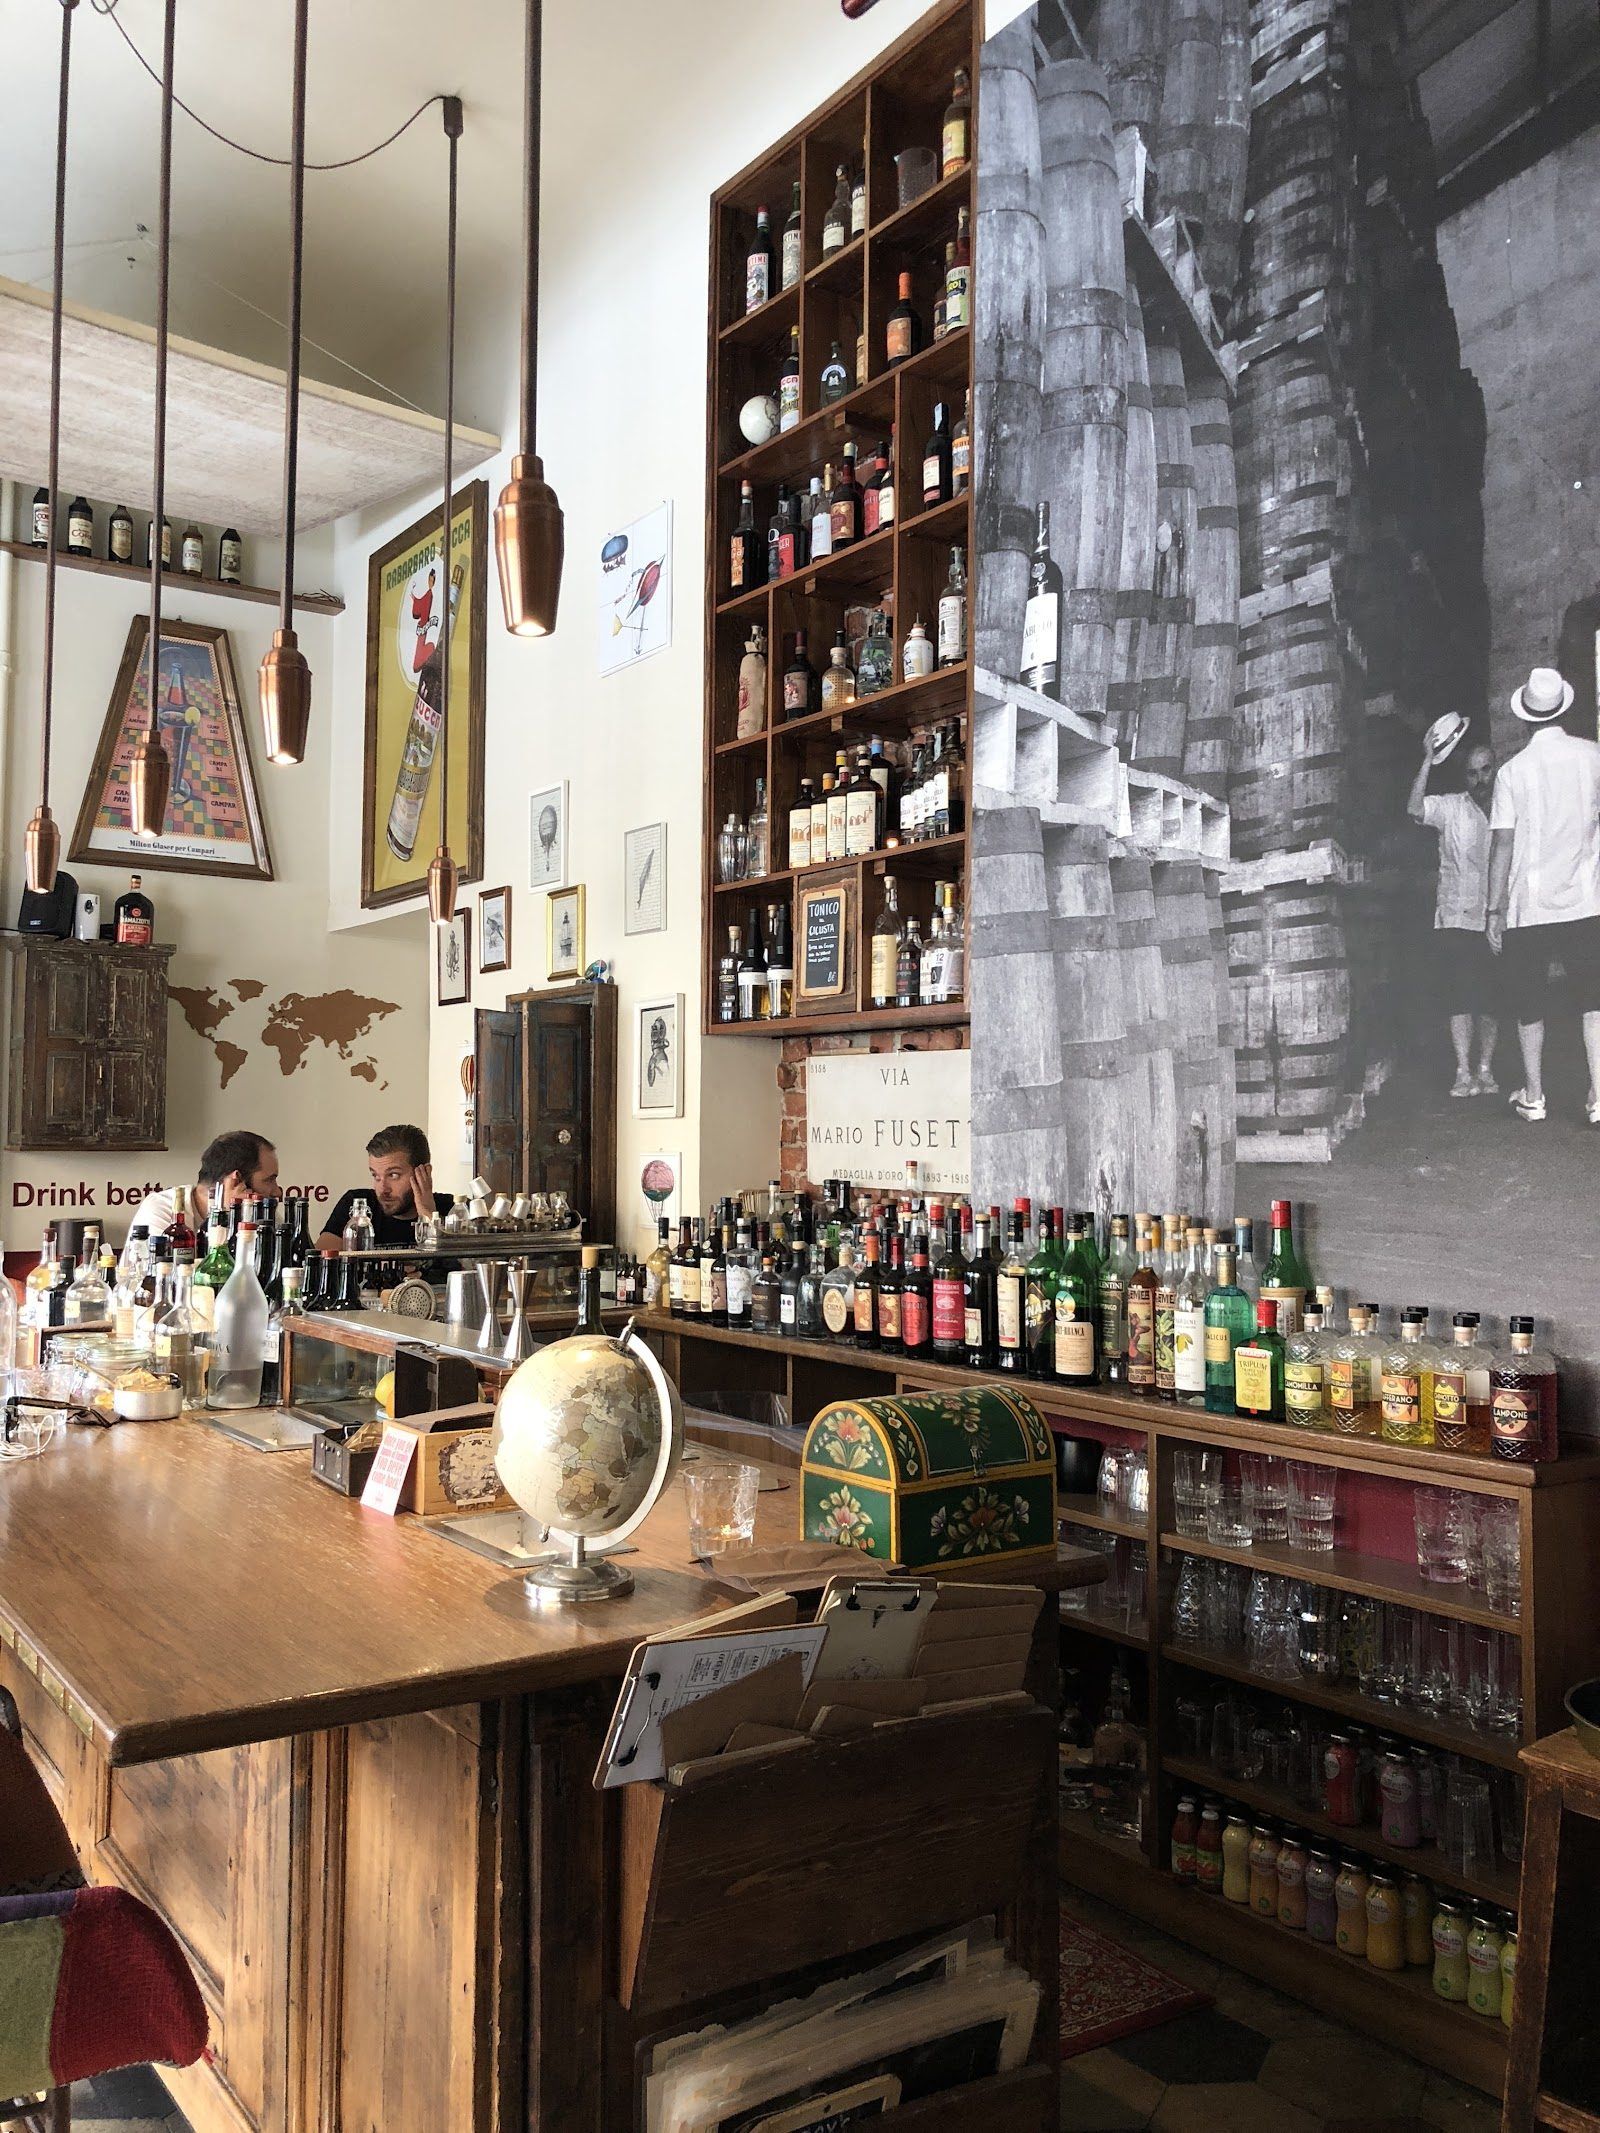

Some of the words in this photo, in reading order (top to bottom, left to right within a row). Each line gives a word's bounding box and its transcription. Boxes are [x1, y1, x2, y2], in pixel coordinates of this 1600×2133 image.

[386, 542, 436, 592] RABARBARO
[440, 518, 471, 557] ZCCA
[210, 800, 237, 809] CAMPAR
[129, 839, 152, 850] Milton
[152, 841, 175, 851] Glaser
[175, 844, 187, 853] per
[186, 845, 216, 856] Campari
[809, 901, 839, 918] TONICO
[879, 1067, 911, 1086] VIA
[811, 1125, 863, 1144] MARIO
[874, 1119, 972, 1149] FUSET
[832, 1167, 874, 1181] MEDAGLIA
[878, 1170, 904, 1181] D'ORO
[12, 1180, 96, 1208] Drink
[106, 1180, 163, 1206] bet
[277, 1184, 330, 1203] ore
[1493, 1407, 1529, 1420] LAMPONE
